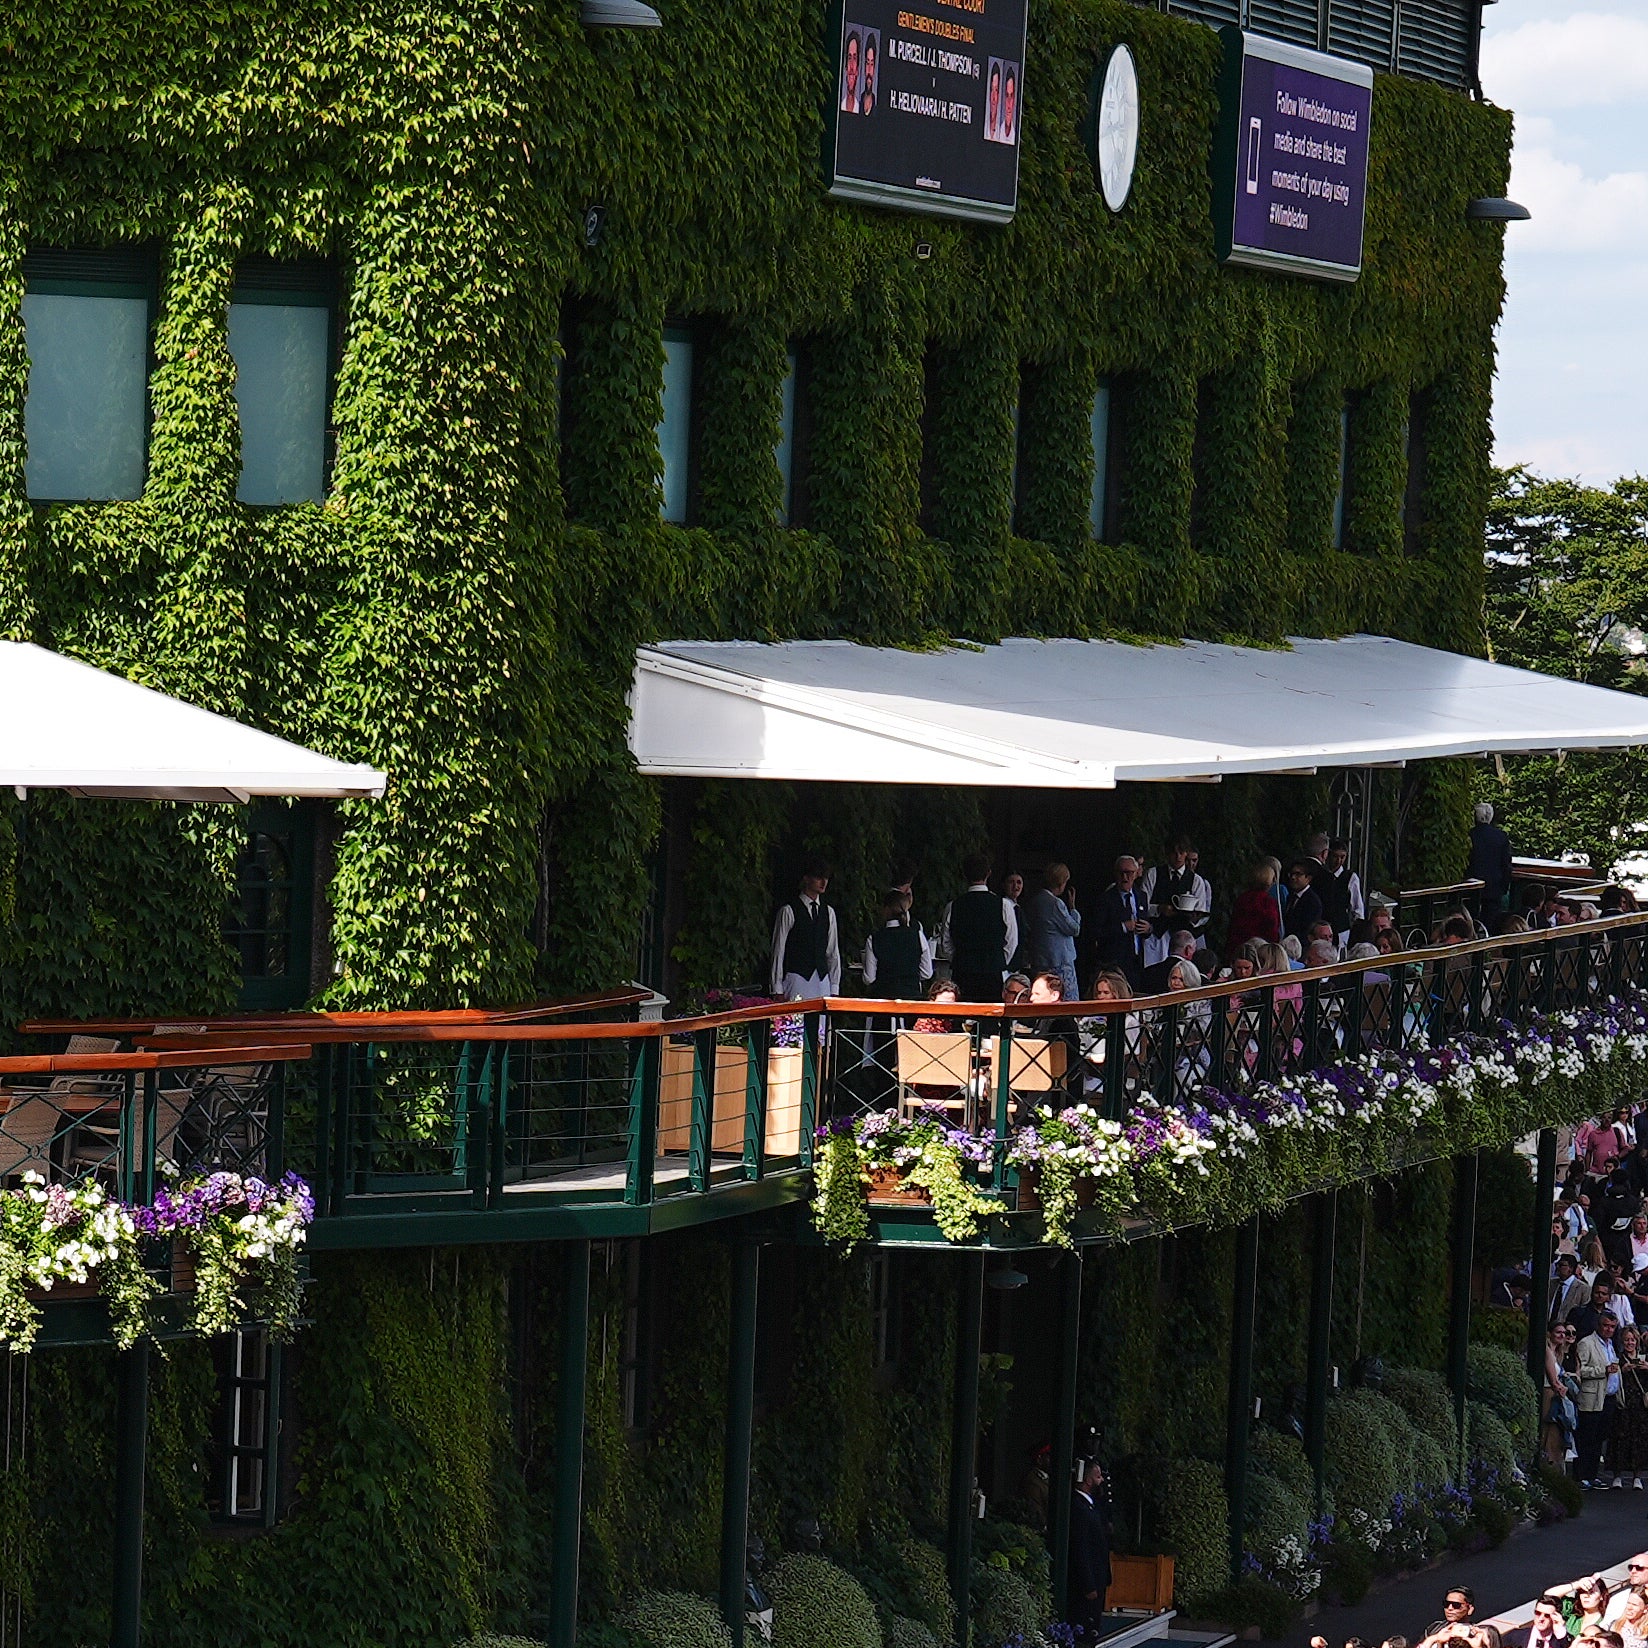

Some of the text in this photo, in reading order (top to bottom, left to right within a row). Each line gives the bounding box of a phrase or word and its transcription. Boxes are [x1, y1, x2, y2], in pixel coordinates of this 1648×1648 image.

[960, 26, 975, 44] FINAL
[898, 40, 926, 65] PURCELL
[938, 49, 972, 76] THOMPSON
[898, 91, 938, 117] HELIOVAARA
[948, 102, 973, 124] PATTEN
[1276, 90, 1358, 132] Follow Wimbledon on social
[1273, 130, 1346, 165] media and share the best
[1271, 170, 1350, 207] moments of your day using
[1269, 202, 1309, 231] #Wimbledon
